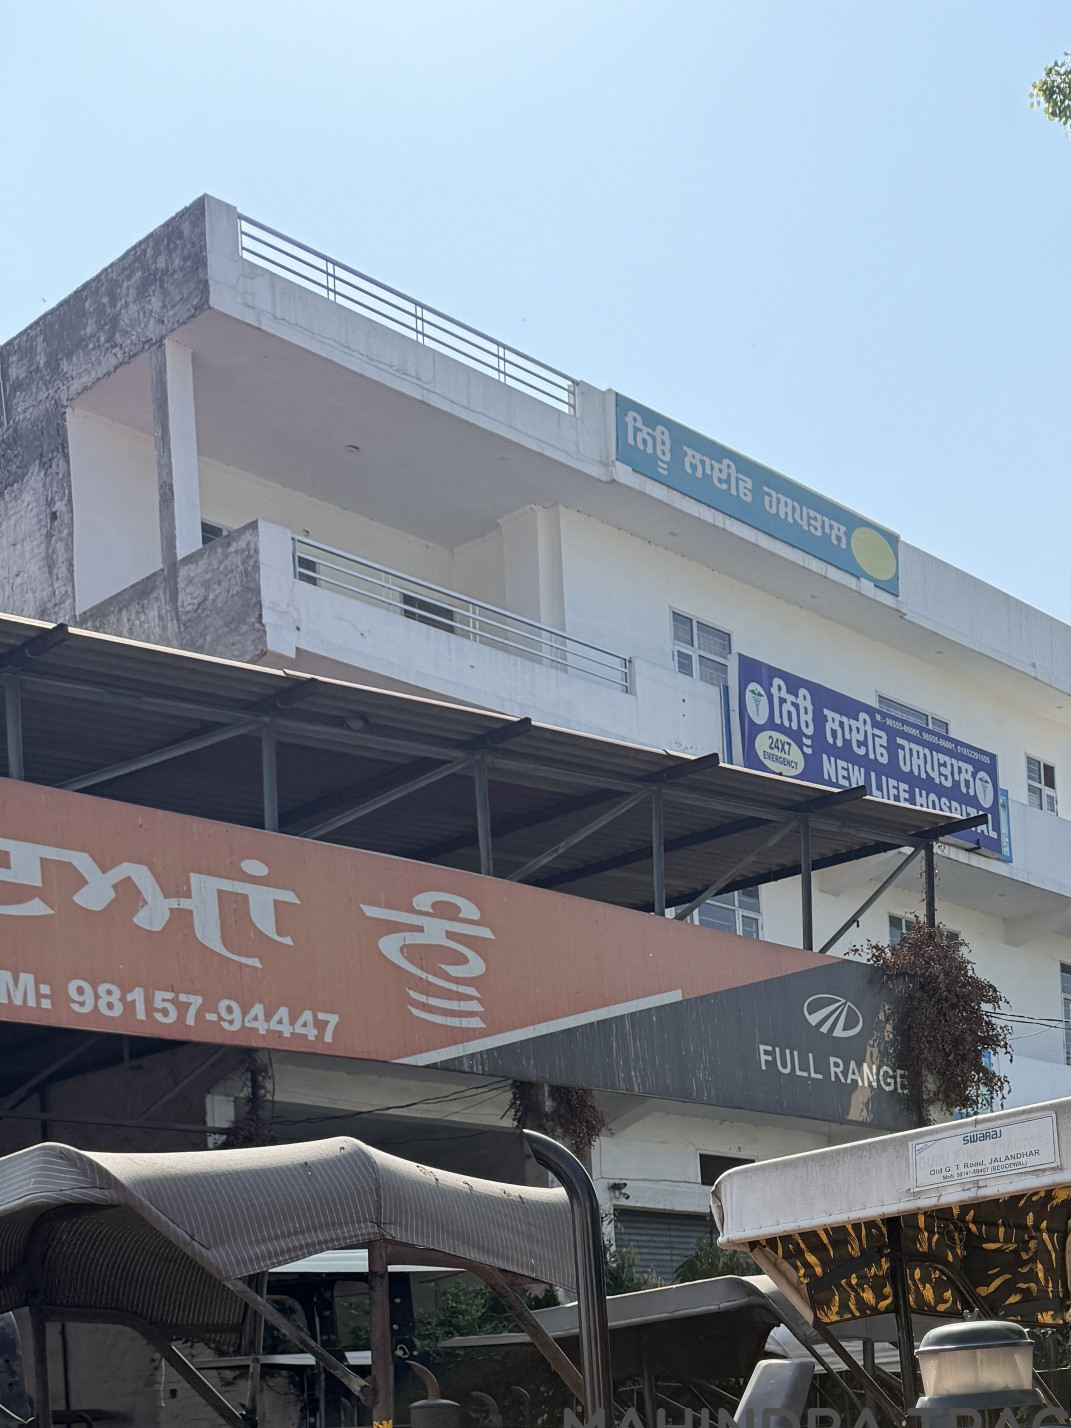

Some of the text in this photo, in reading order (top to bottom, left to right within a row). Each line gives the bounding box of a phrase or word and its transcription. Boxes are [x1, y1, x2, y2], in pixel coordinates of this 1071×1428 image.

[625, 410, 847, 549] ਨਿਊ ਲਾਈਫ ਹਸਪਤਾਲ
[763, 750, 798, 770] EMERGENCY
[768, 735, 792, 757] 24X7
[771, 677, 974, 796] ਨਿਊ ਲਾਈਫ ਹਸਪਤਾਲ
[822, 754, 865, 786] NEW
[870, 771, 910, 804] LIFE
[68, 979, 340, 1043] 98157-94447
[759, 1044, 909, 1095] FULL RANGE
[929, 1168, 943, 1176] Old
[963, 1160, 986, 1170] Road,
[988, 1149, 1040, 1165] JALANDHAR
